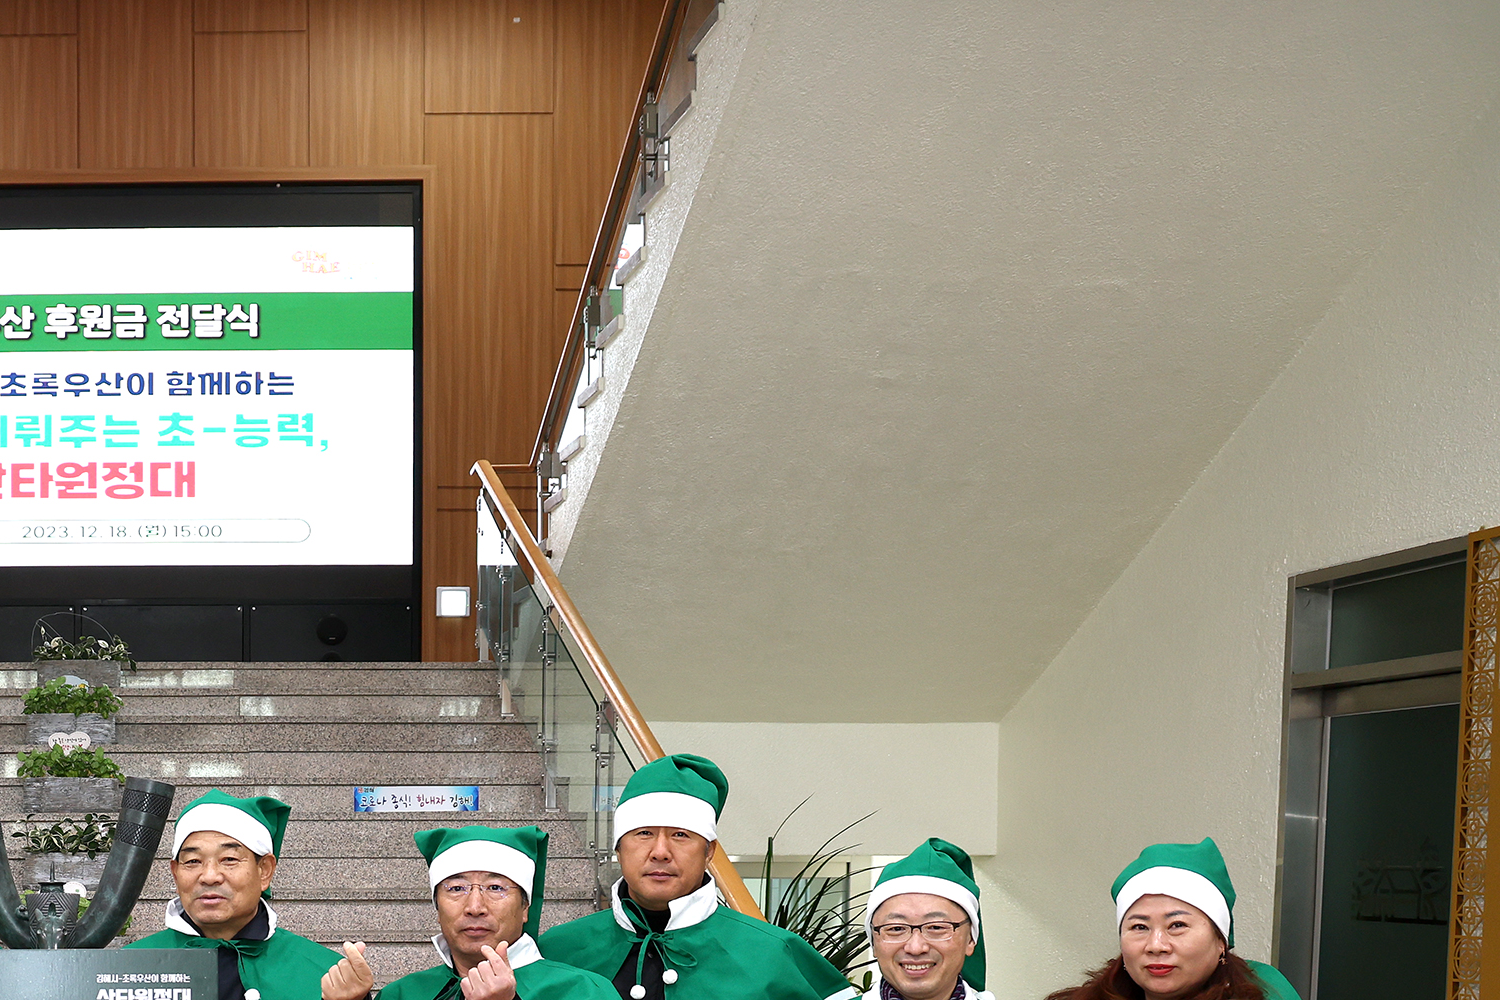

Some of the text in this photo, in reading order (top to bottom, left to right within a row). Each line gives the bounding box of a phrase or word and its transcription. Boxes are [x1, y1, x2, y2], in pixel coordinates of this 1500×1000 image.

[44, 304, 148, 339] 후원금
[157, 303, 261, 338] 전달식
[0, 372, 155, 398] 초록우산이
[168, 371, 296, 397] 함께하는
[157, 412, 330, 453] 초-능력,
[22, 525, 73, 539] 2023.
[174, 525, 223, 538] 15:00
[360, 796, 387, 807] 코로나
